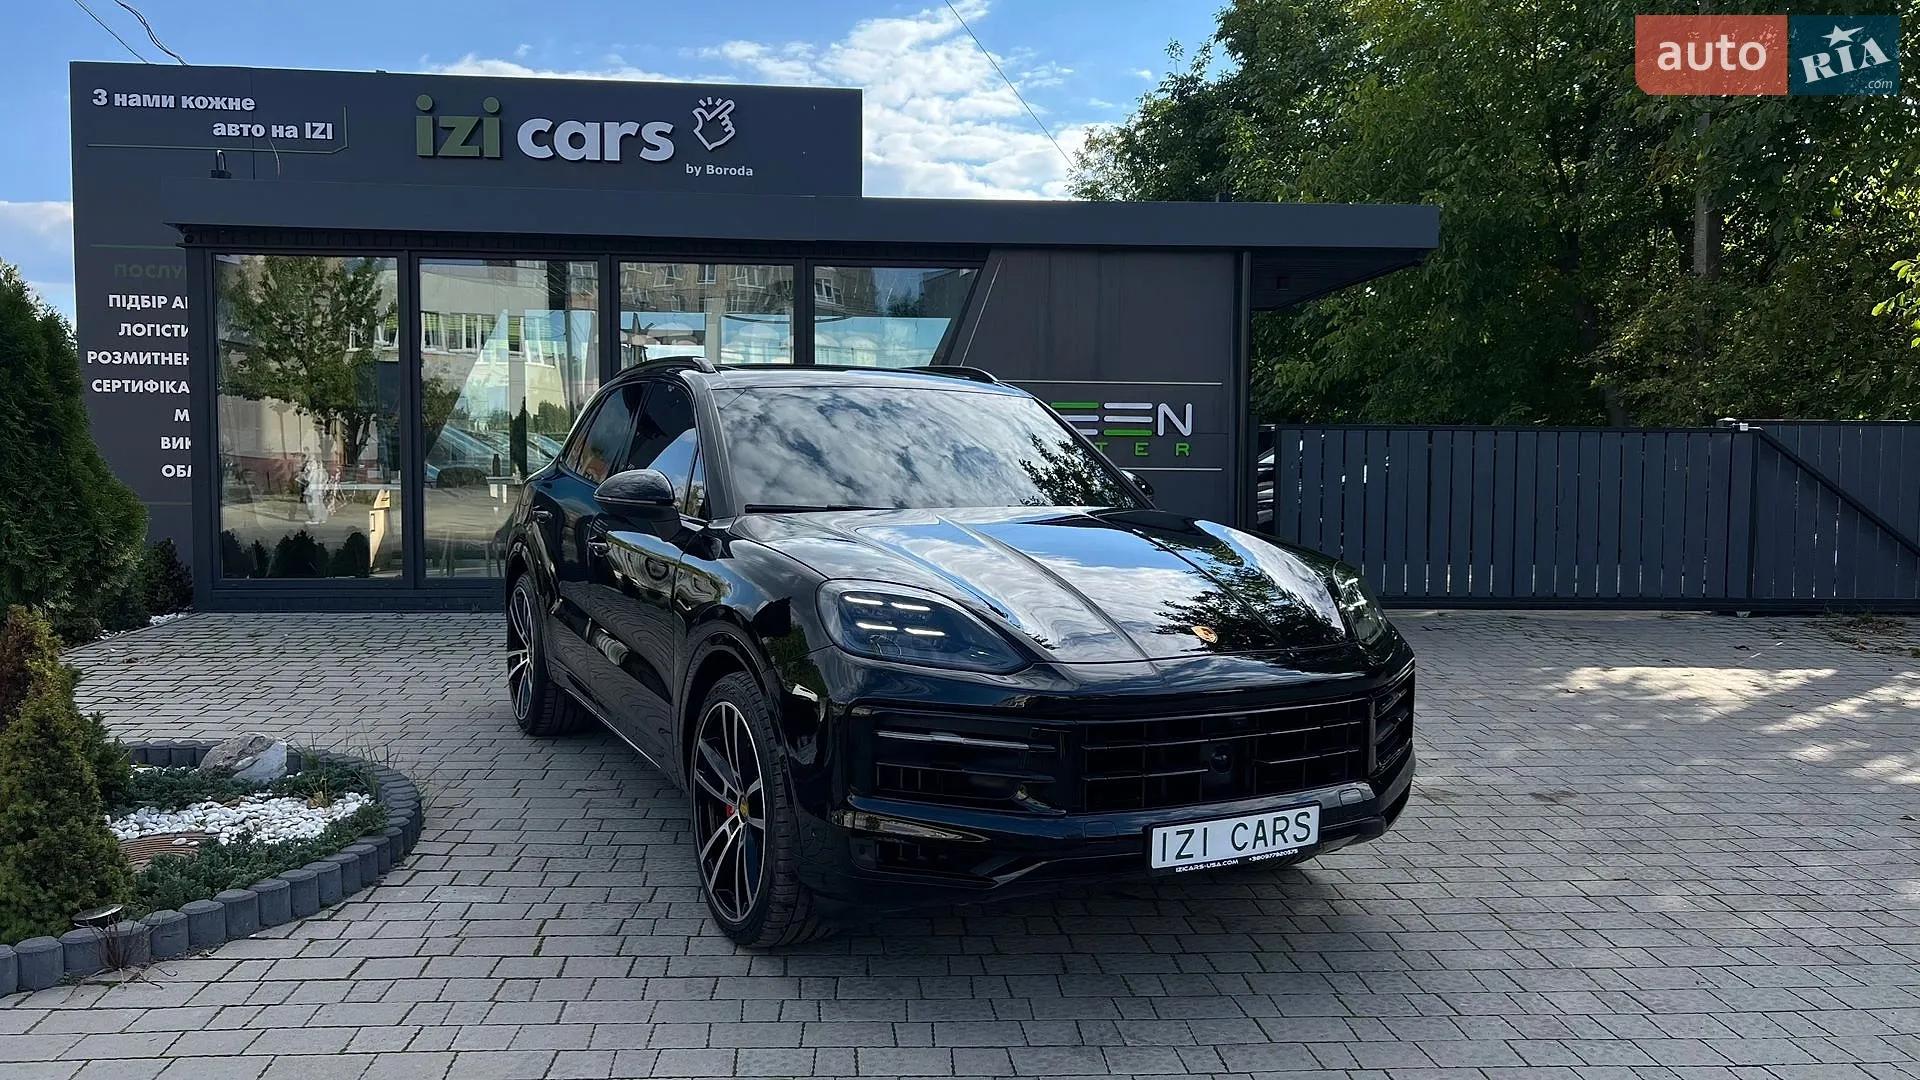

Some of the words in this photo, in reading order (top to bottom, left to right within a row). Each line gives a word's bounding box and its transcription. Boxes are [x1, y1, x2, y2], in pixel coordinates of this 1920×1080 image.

[92, 88, 108, 107] З
[114, 91, 175, 109] нами
[181, 94, 256, 111] кожне
[212, 120, 266, 138] авто
[271, 123, 299, 139] на
[305, 122, 334, 140] IZI
[415, 94, 501, 158] izi
[516, 117, 675, 162] cars
[685, 164, 702, 178] by
[706, 164, 754, 178] Boroda
[108, 294, 168, 310] ПІДБІР
[91, 379, 190, 394] СЕРТИФІКА
[1161, 827, 1208, 862] IZI
[1231, 812, 1311, 852] CARS
